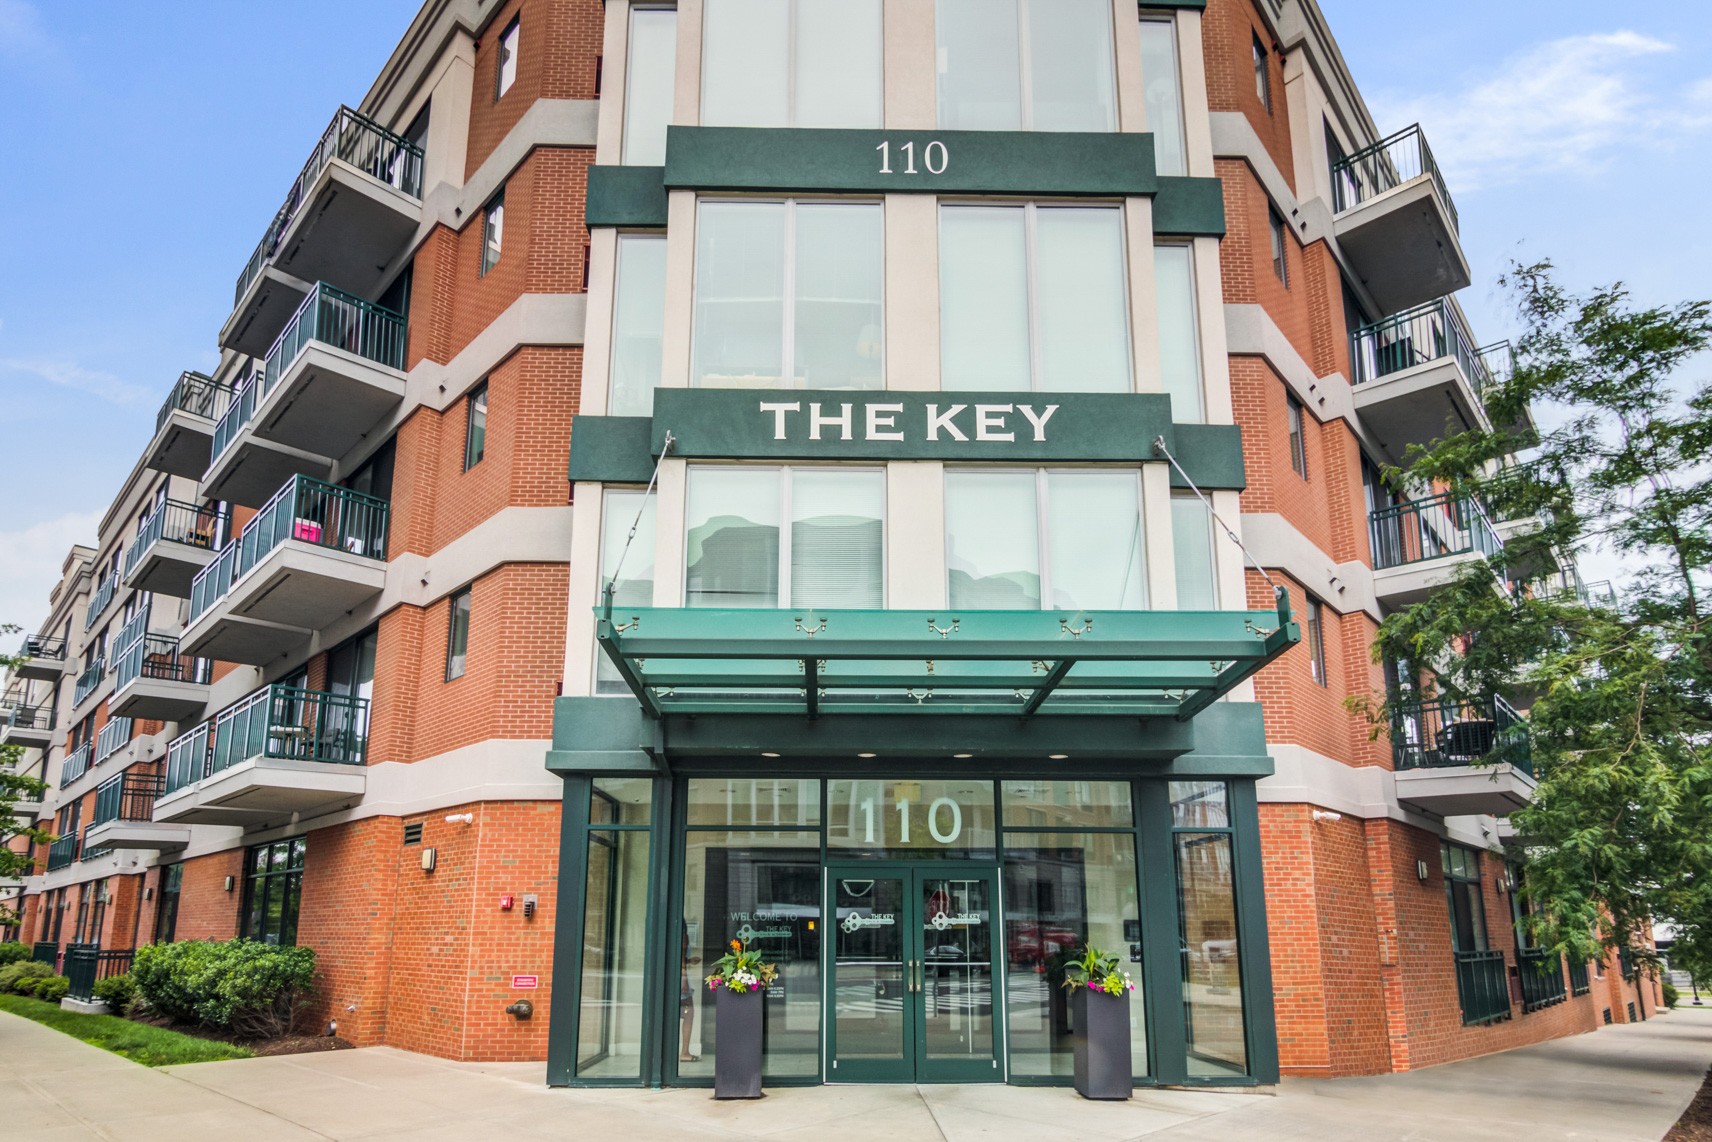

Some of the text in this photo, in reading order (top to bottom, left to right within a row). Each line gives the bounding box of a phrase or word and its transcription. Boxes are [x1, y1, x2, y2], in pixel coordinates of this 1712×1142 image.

[876, 141, 949, 174] 110
[760, 401, 1060, 442] THE KEY
[861, 797, 962, 844] 110
[730, 912, 798, 921] WELCOME TO
